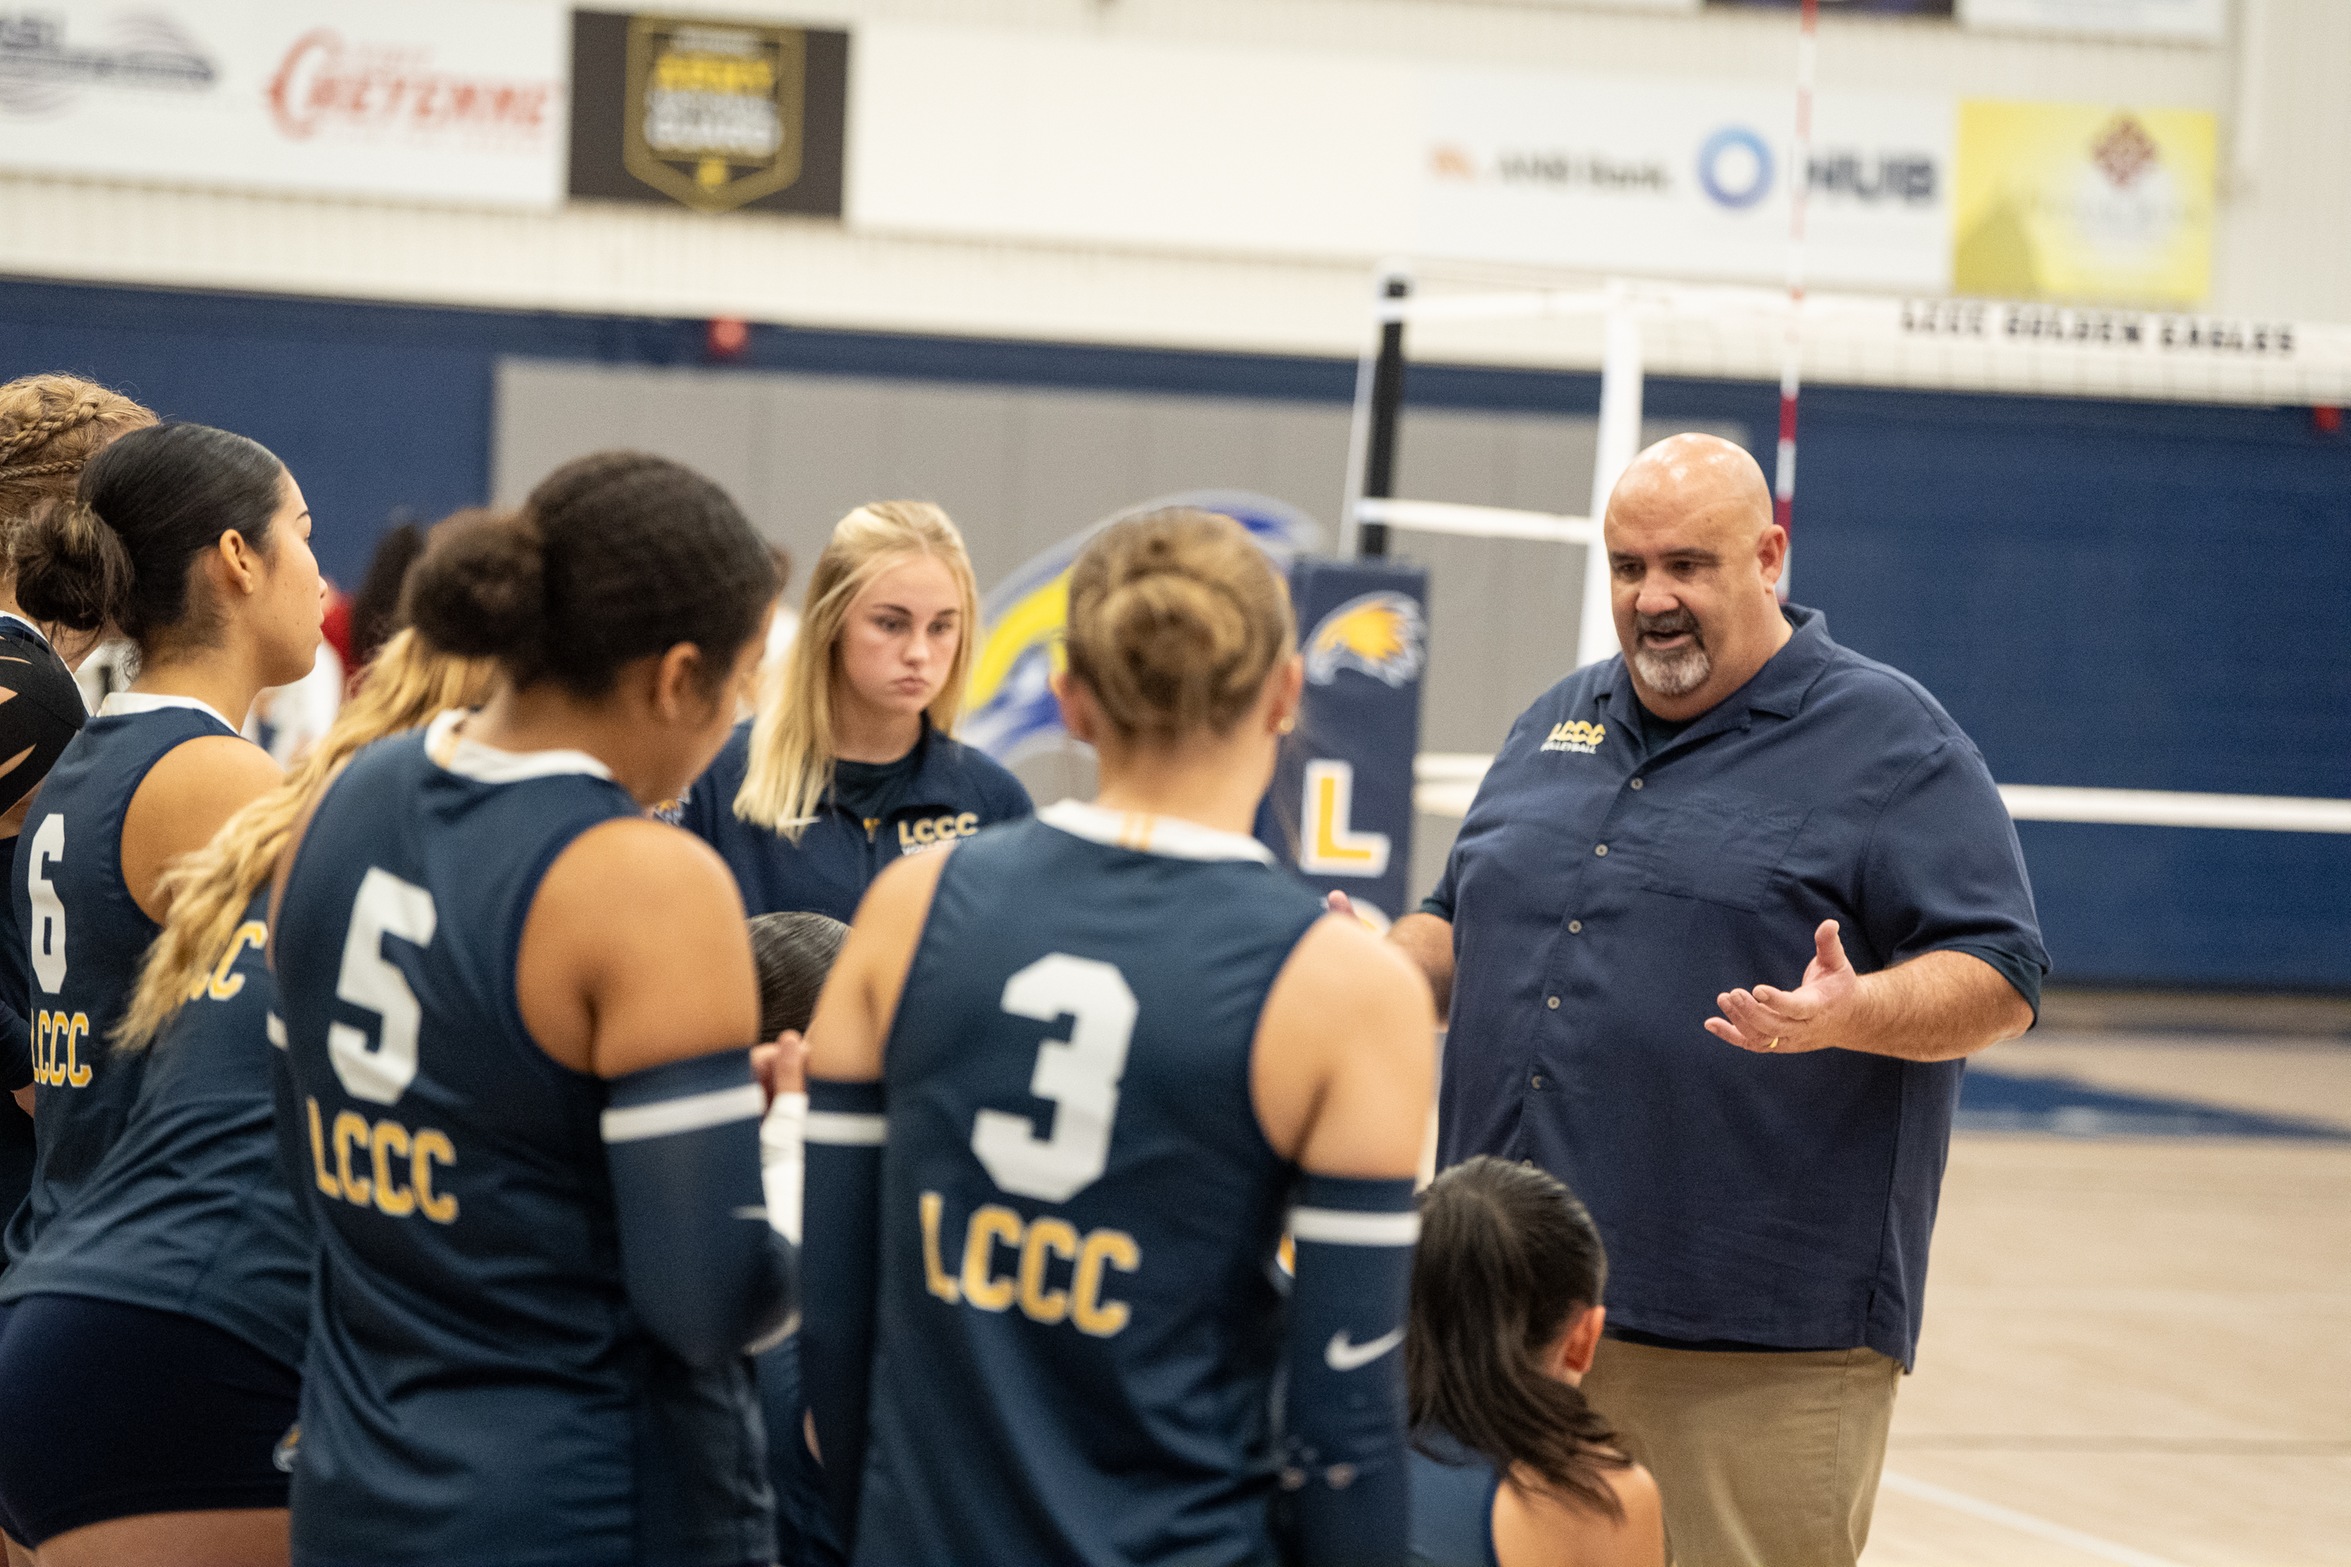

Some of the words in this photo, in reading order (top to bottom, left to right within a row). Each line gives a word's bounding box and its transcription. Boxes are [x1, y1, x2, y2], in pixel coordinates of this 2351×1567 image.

[1547, 720, 1606, 746] LCCC
[898, 811, 979, 846] LCCC
[28, 813, 67, 994] 6
[327, 866, 437, 1106] 5
[971, 951, 1139, 1204] 3
[306, 1096, 458, 1224] LCCC
[919, 1191, 1140, 1338] LCCC
